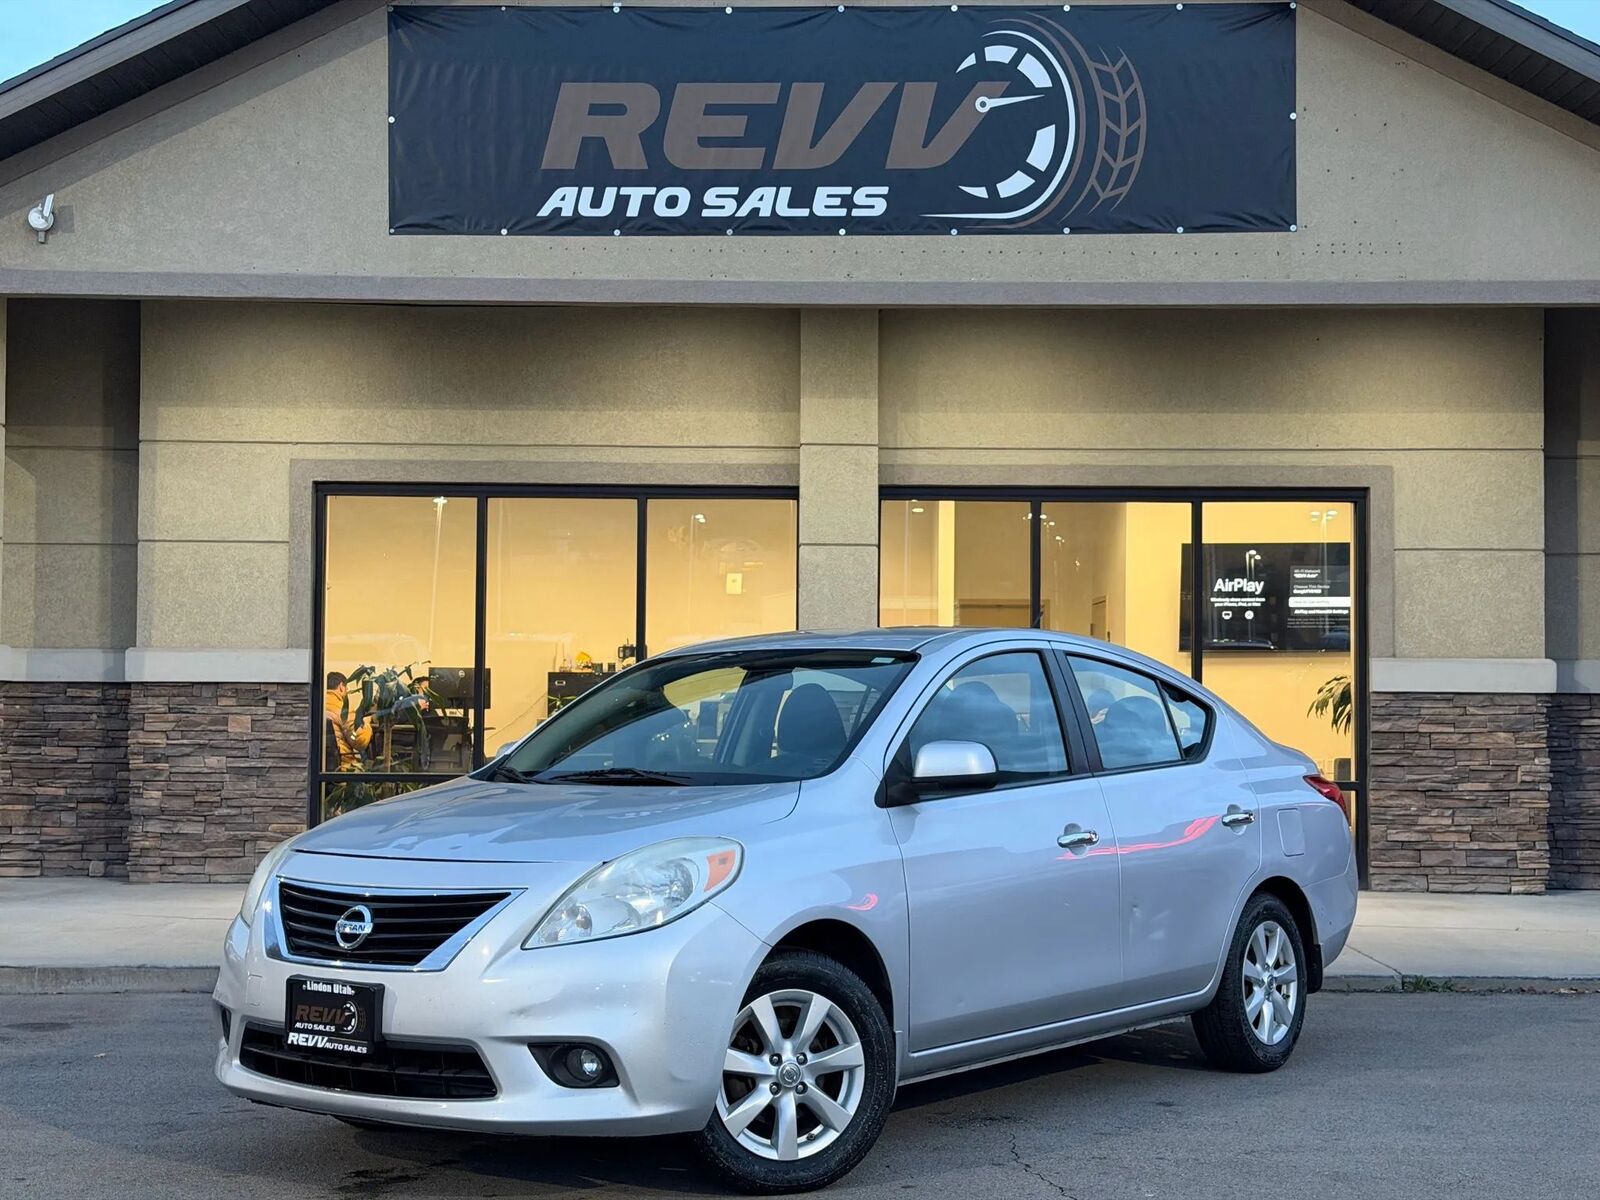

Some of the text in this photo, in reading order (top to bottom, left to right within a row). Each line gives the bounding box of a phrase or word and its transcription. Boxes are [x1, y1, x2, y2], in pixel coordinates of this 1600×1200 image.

[540, 82, 1011, 170] REVV
[536, 186, 890, 217] AUTO SALES
[1213, 577, 1265, 595] AirPlay
[306, 981, 352, 995] Lindon Utah
[295, 1005, 349, 1025] REVV
[294, 1022, 336, 1032] AUTO SALES
[287, 1032, 367, 1054] REVV AUTO SALES
